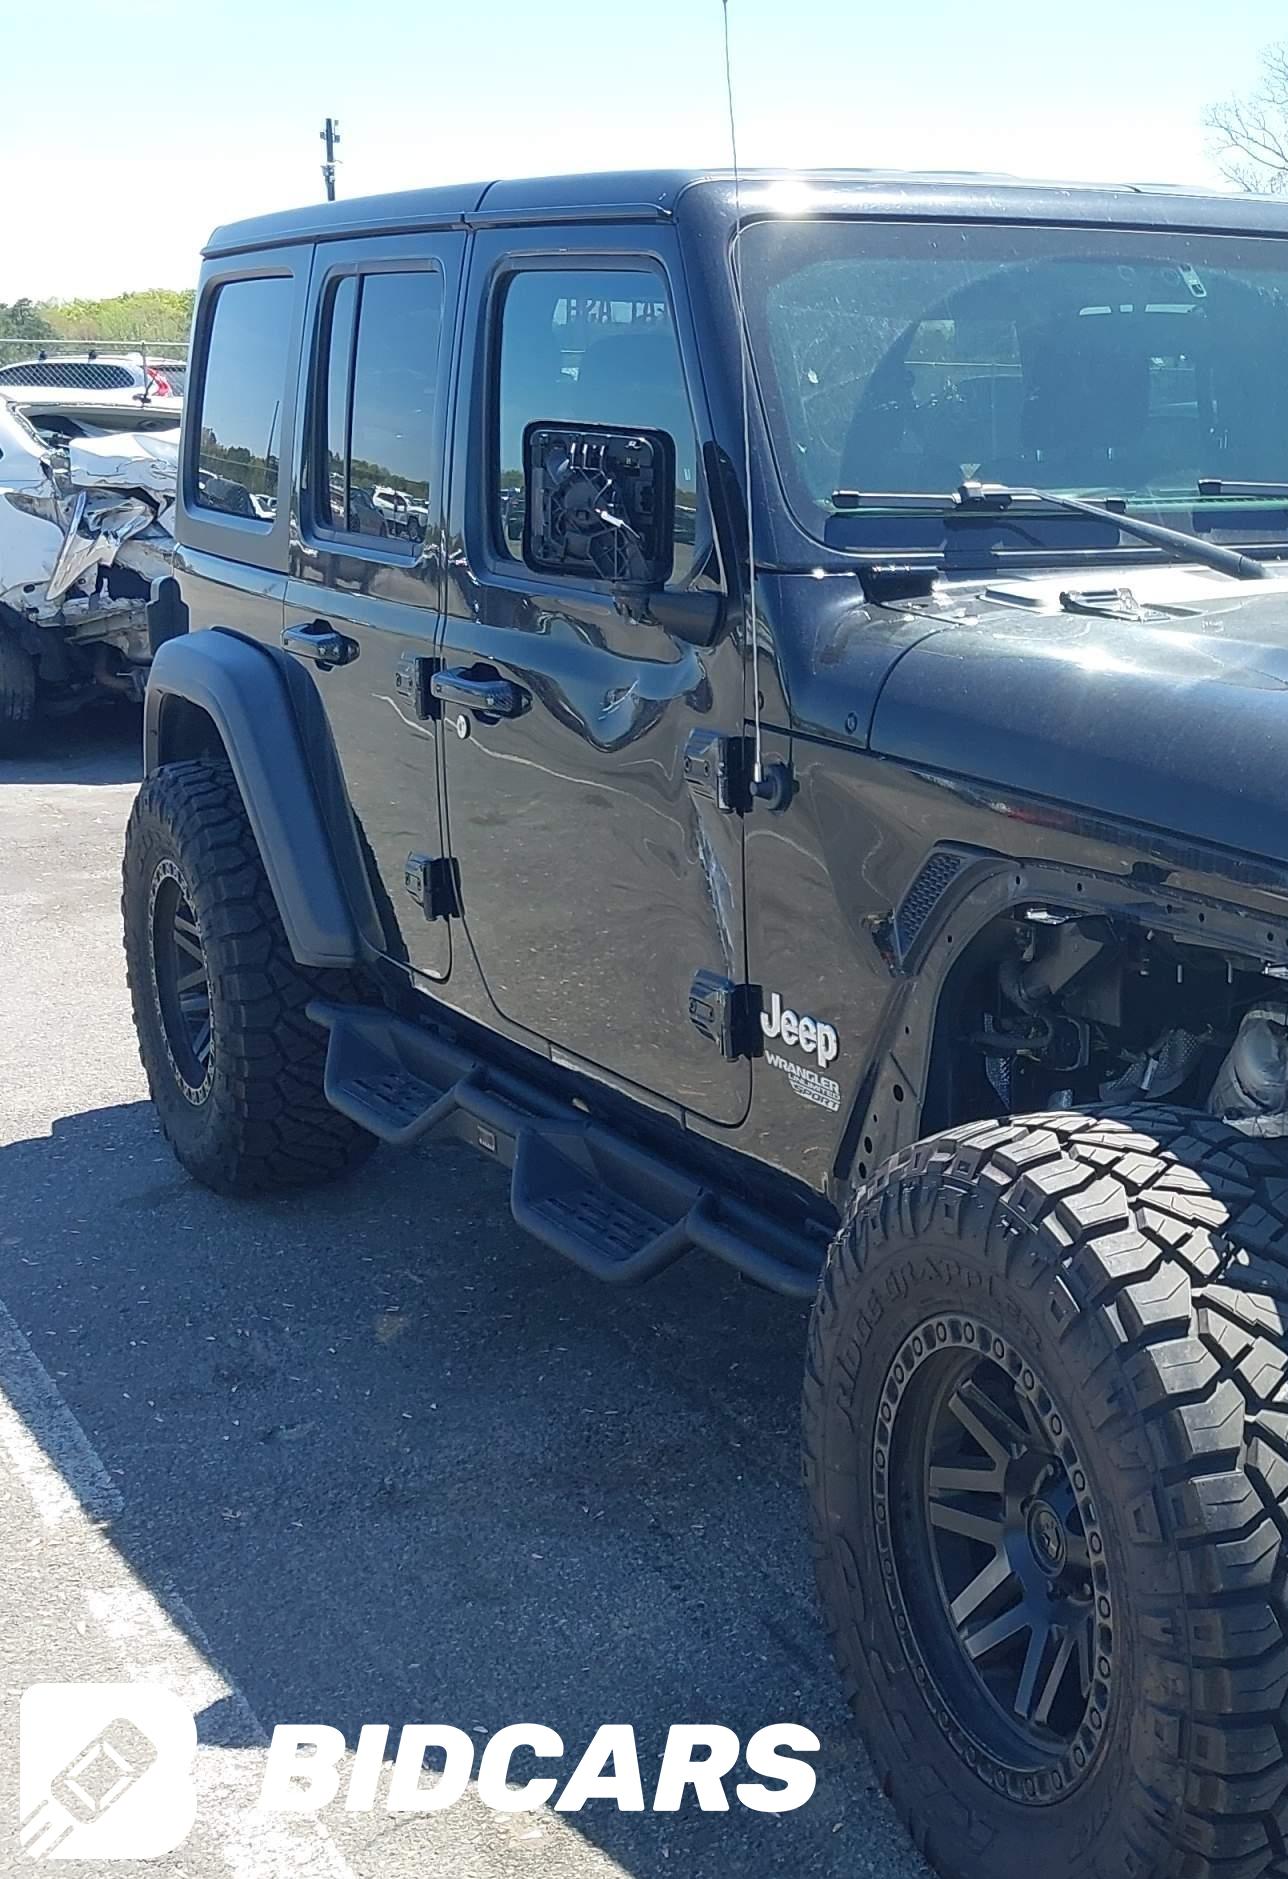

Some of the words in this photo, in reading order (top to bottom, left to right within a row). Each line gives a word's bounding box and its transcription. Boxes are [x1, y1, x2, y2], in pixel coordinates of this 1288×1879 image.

[760, 991, 838, 1069] Jeep
[764, 1050, 840, 1095] WRANGLER
[787, 1073, 841, 1101] UNLIMITED
[791, 1081, 841, 1112] SPORT
